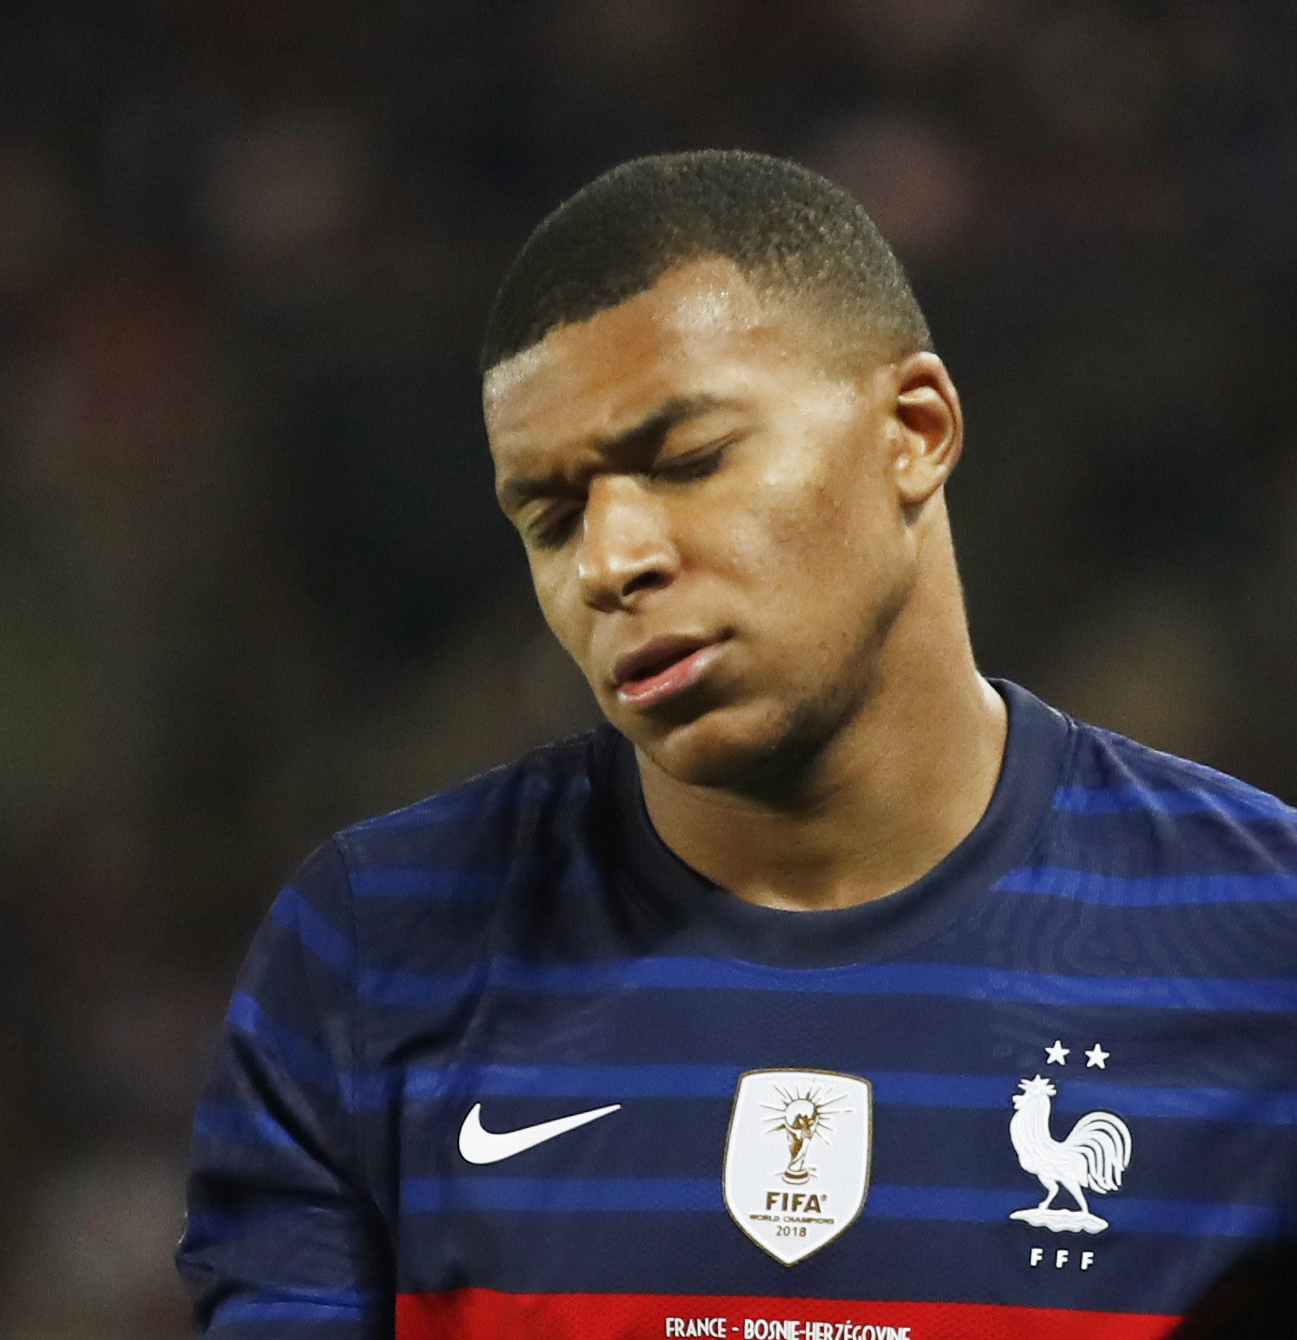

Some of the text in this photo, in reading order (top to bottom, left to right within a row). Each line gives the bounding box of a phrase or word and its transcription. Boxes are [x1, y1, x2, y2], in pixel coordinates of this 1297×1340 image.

[749, 1214, 835, 1225] WORLD CHAMPIONS
[775, 1225, 807, 1238] 2018
[665, 1317, 727, 1338] FRANCE
